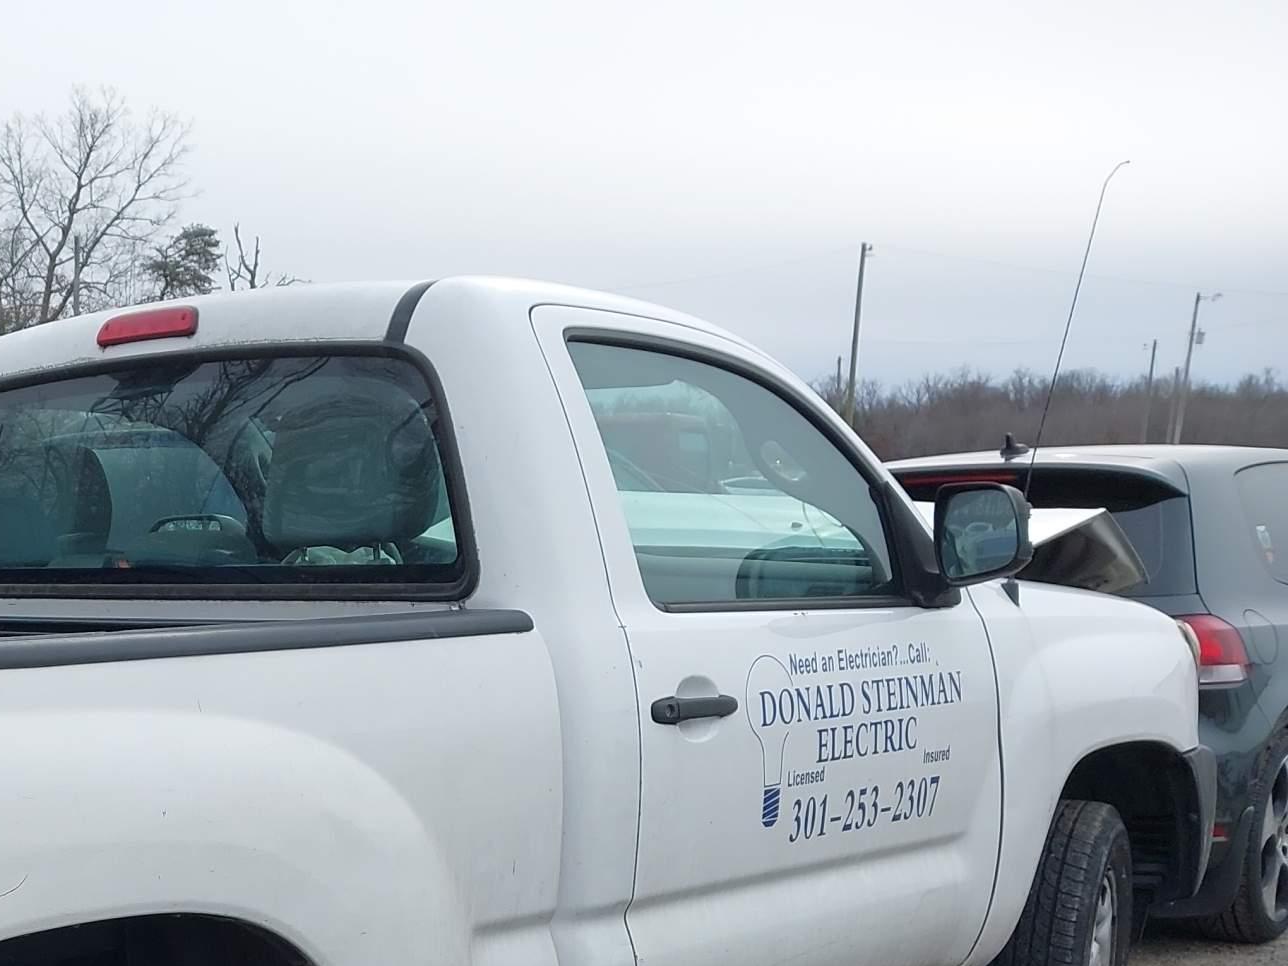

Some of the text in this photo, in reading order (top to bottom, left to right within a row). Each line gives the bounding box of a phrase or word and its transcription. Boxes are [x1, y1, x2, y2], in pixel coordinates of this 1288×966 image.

[789, 652, 818, 676] Need
[821, 655, 835, 673] an
[759, 671, 963, 727] DONALD STEINMAN
[816, 717, 918, 763] ELECTRIC
[922, 745, 951, 765] Insured
[787, 766, 825, 788] Licensed
[788, 775, 941, 843] 301-253-2307
